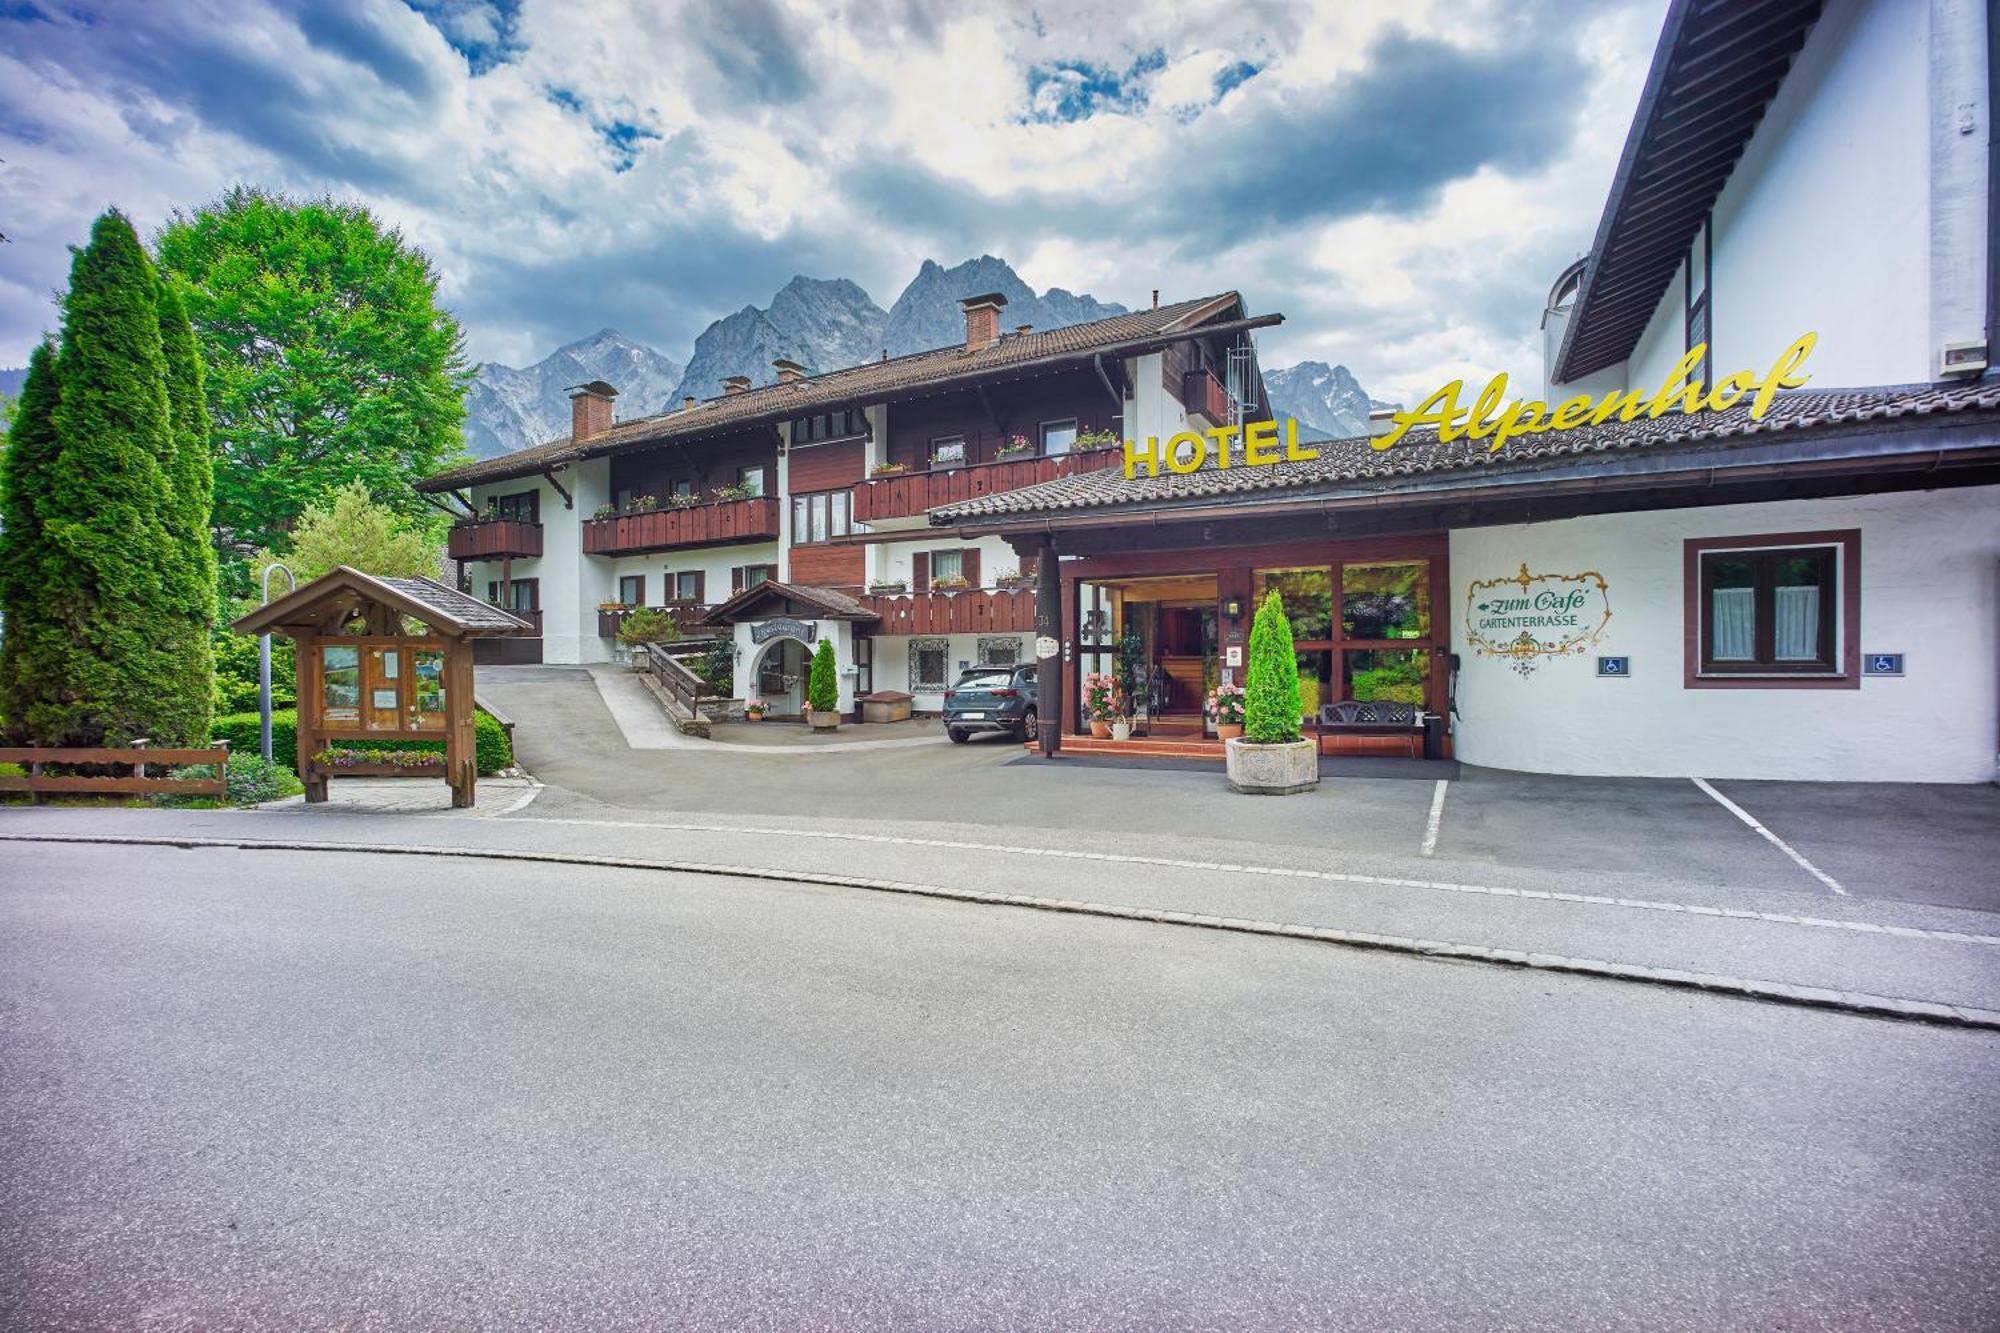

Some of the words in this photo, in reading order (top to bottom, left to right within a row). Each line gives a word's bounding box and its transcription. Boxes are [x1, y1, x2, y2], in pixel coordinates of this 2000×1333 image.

[1124, 418, 1318, 480] HOTEL
[1369, 331, 1818, 452] Alpenhof
[1534, 589, 1590, 615] Café
[1479, 615, 1578, 630] GARTENTERRASSE
